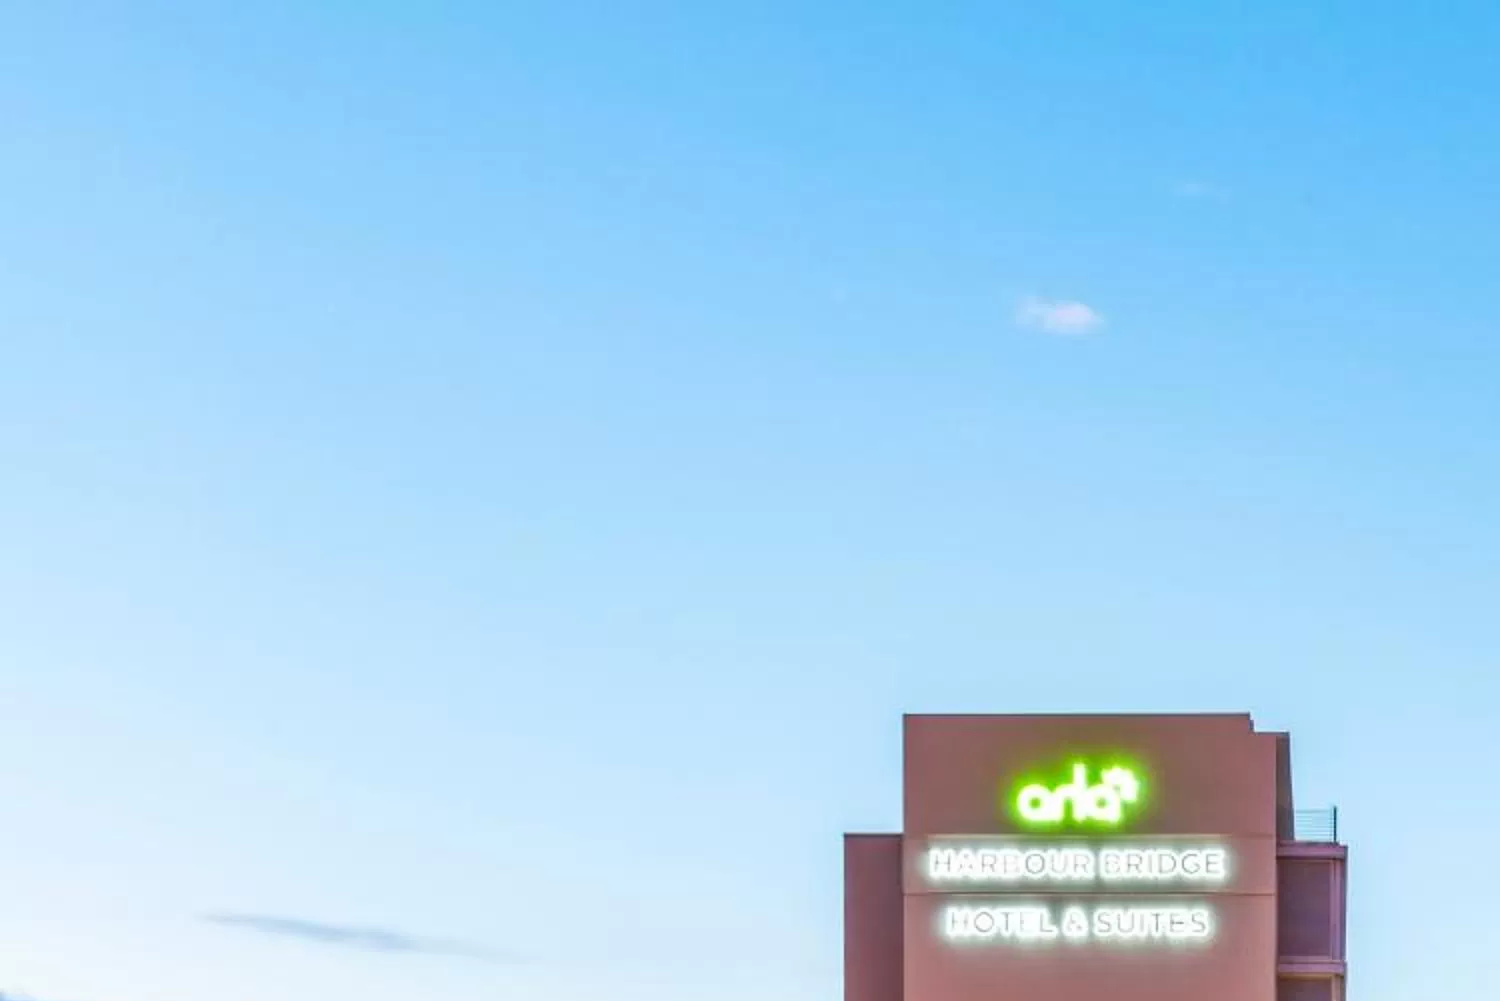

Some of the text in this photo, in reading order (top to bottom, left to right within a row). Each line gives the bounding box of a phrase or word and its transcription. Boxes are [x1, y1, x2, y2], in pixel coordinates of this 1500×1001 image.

[931, 850, 1223, 877] HARBOUR BRIDGE
[947, 909, 1208, 936] HOTEL & SUITES
